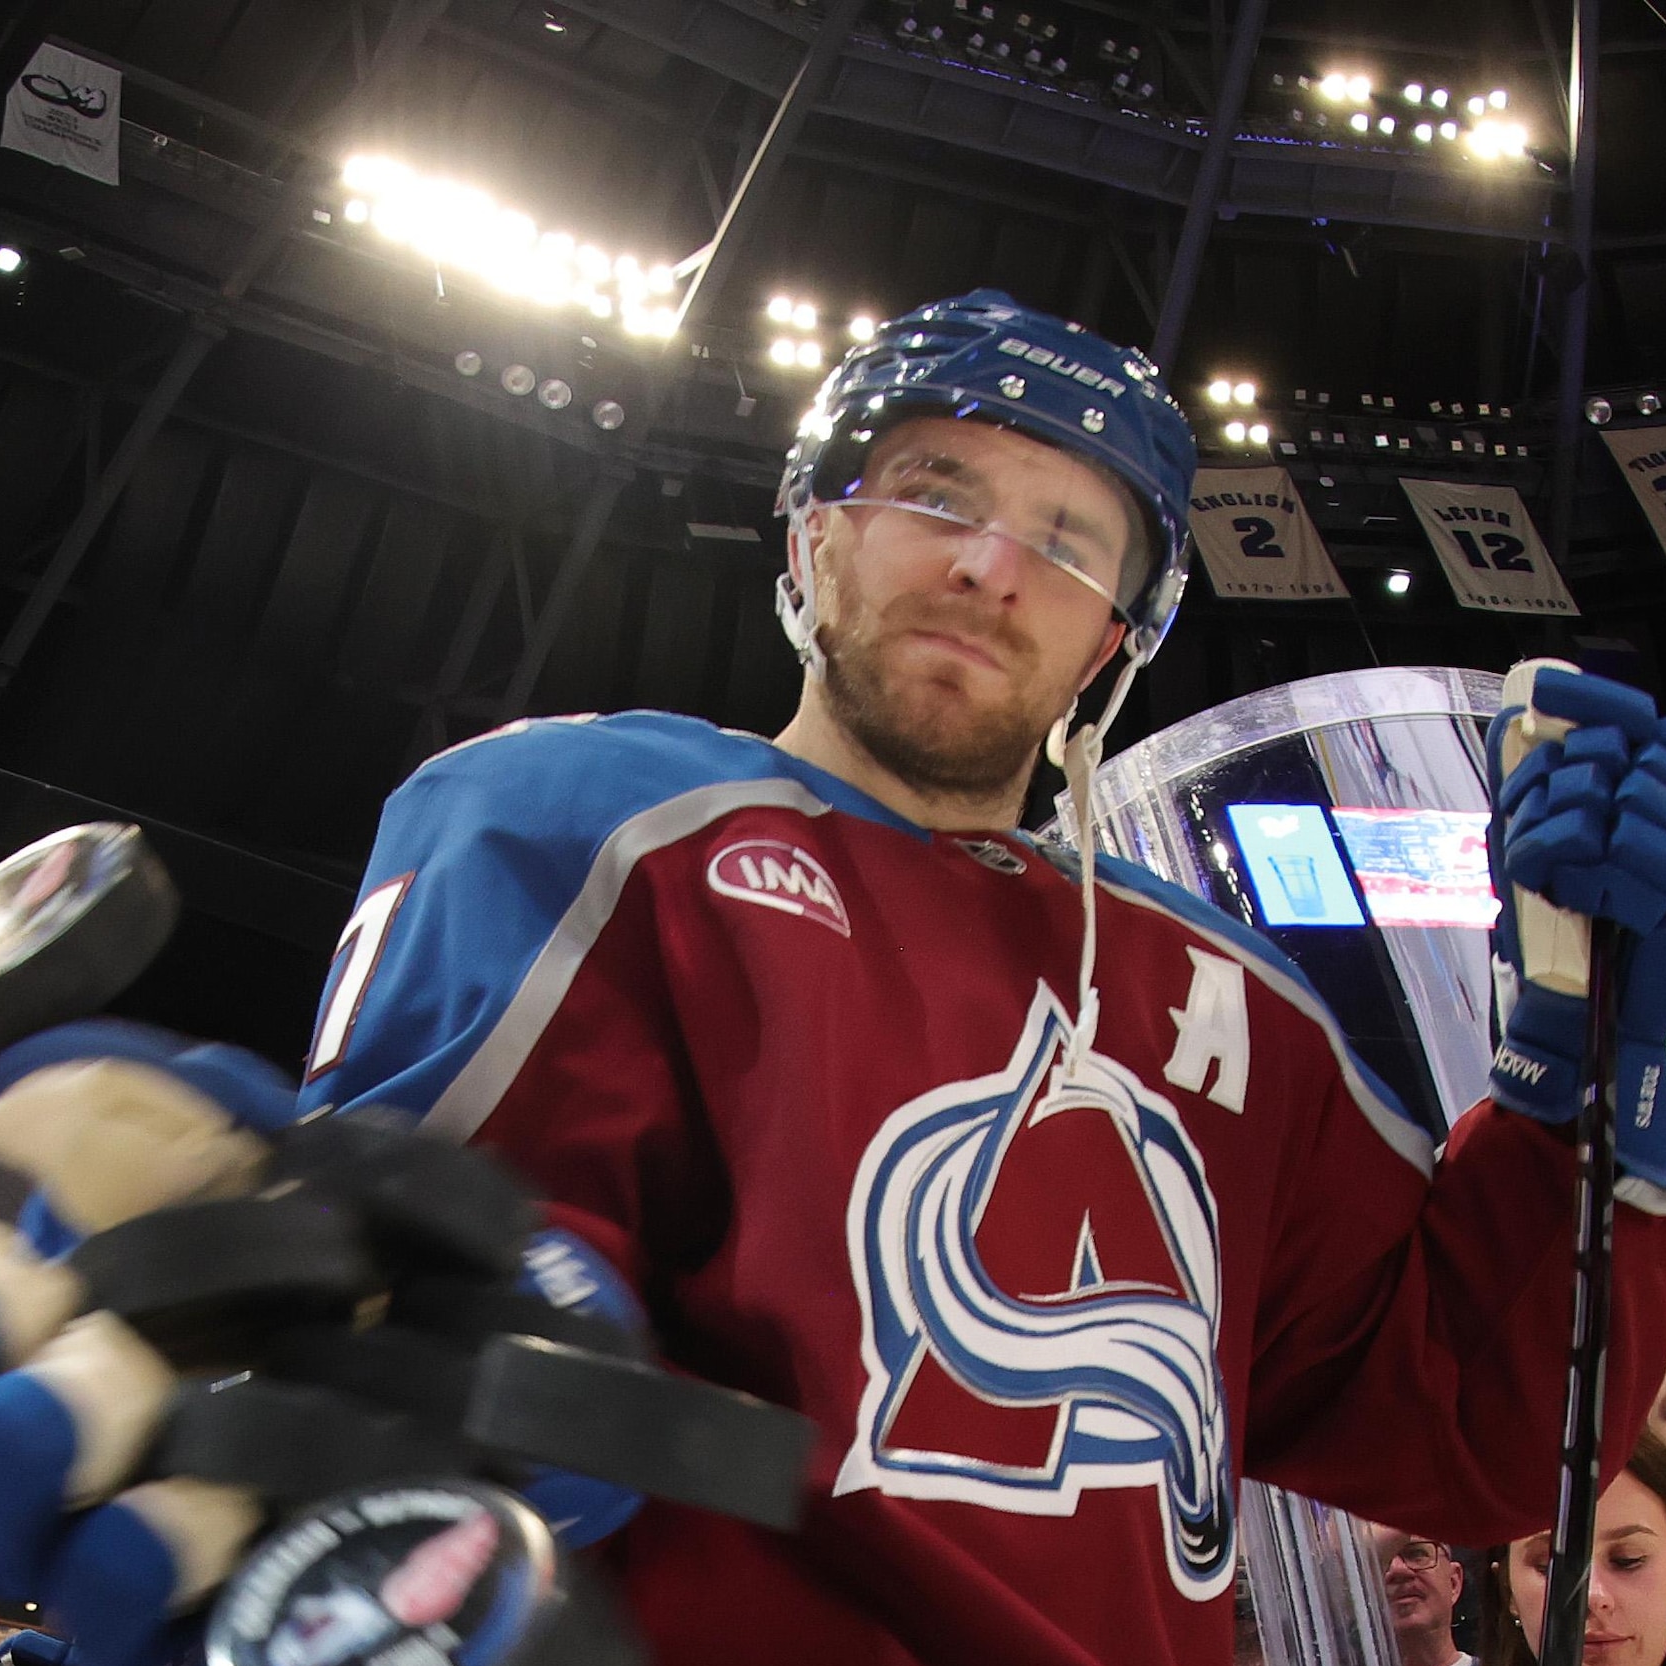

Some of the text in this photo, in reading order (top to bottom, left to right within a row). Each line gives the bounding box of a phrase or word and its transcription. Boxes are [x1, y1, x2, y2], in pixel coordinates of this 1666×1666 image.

[1190, 492, 1296, 514] ENGLISH
[1434, 506, 1512, 528] LEVER
[1232, 516, 1286, 558] 2
[1452, 529, 1535, 574] 12
[738, 853, 843, 921] IMA
[307, 871, 414, 1083] 7
[1164, 944, 1252, 1115] A
